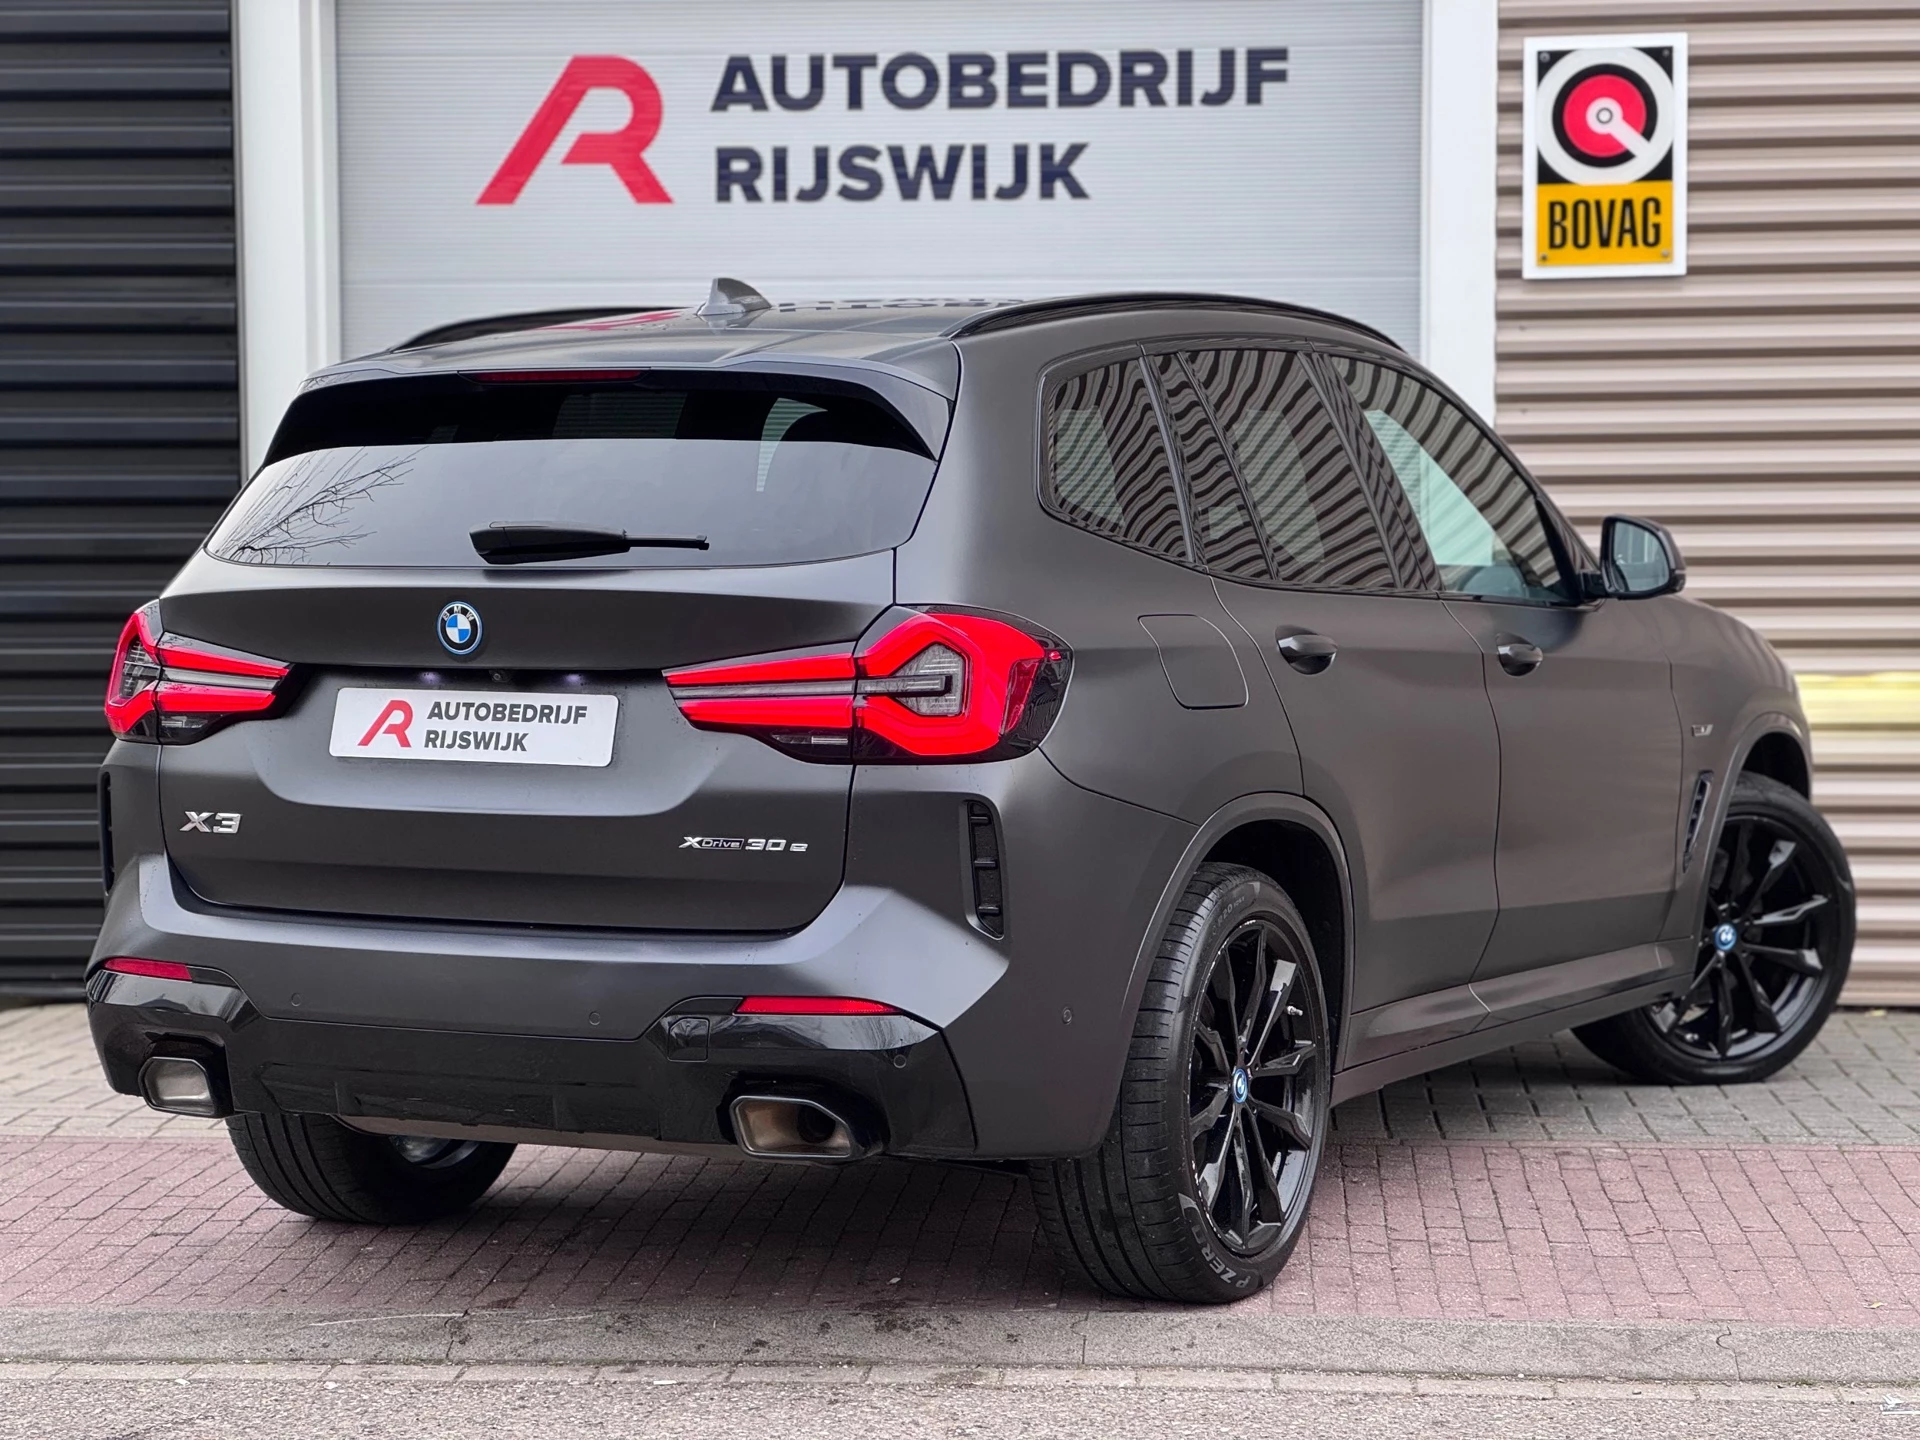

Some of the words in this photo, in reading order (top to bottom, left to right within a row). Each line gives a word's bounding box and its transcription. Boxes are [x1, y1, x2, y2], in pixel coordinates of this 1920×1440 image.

[711, 48, 1289, 112] AUTOBEDRIJF
[715, 143, 1090, 203] RIJSWIJK
[1548, 196, 1661, 250] BOVAG
[427, 701, 588, 725] AUTOBEDRIJF
[424, 729, 529, 752] RIJSWIJK
[179, 811, 243, 834] X3
